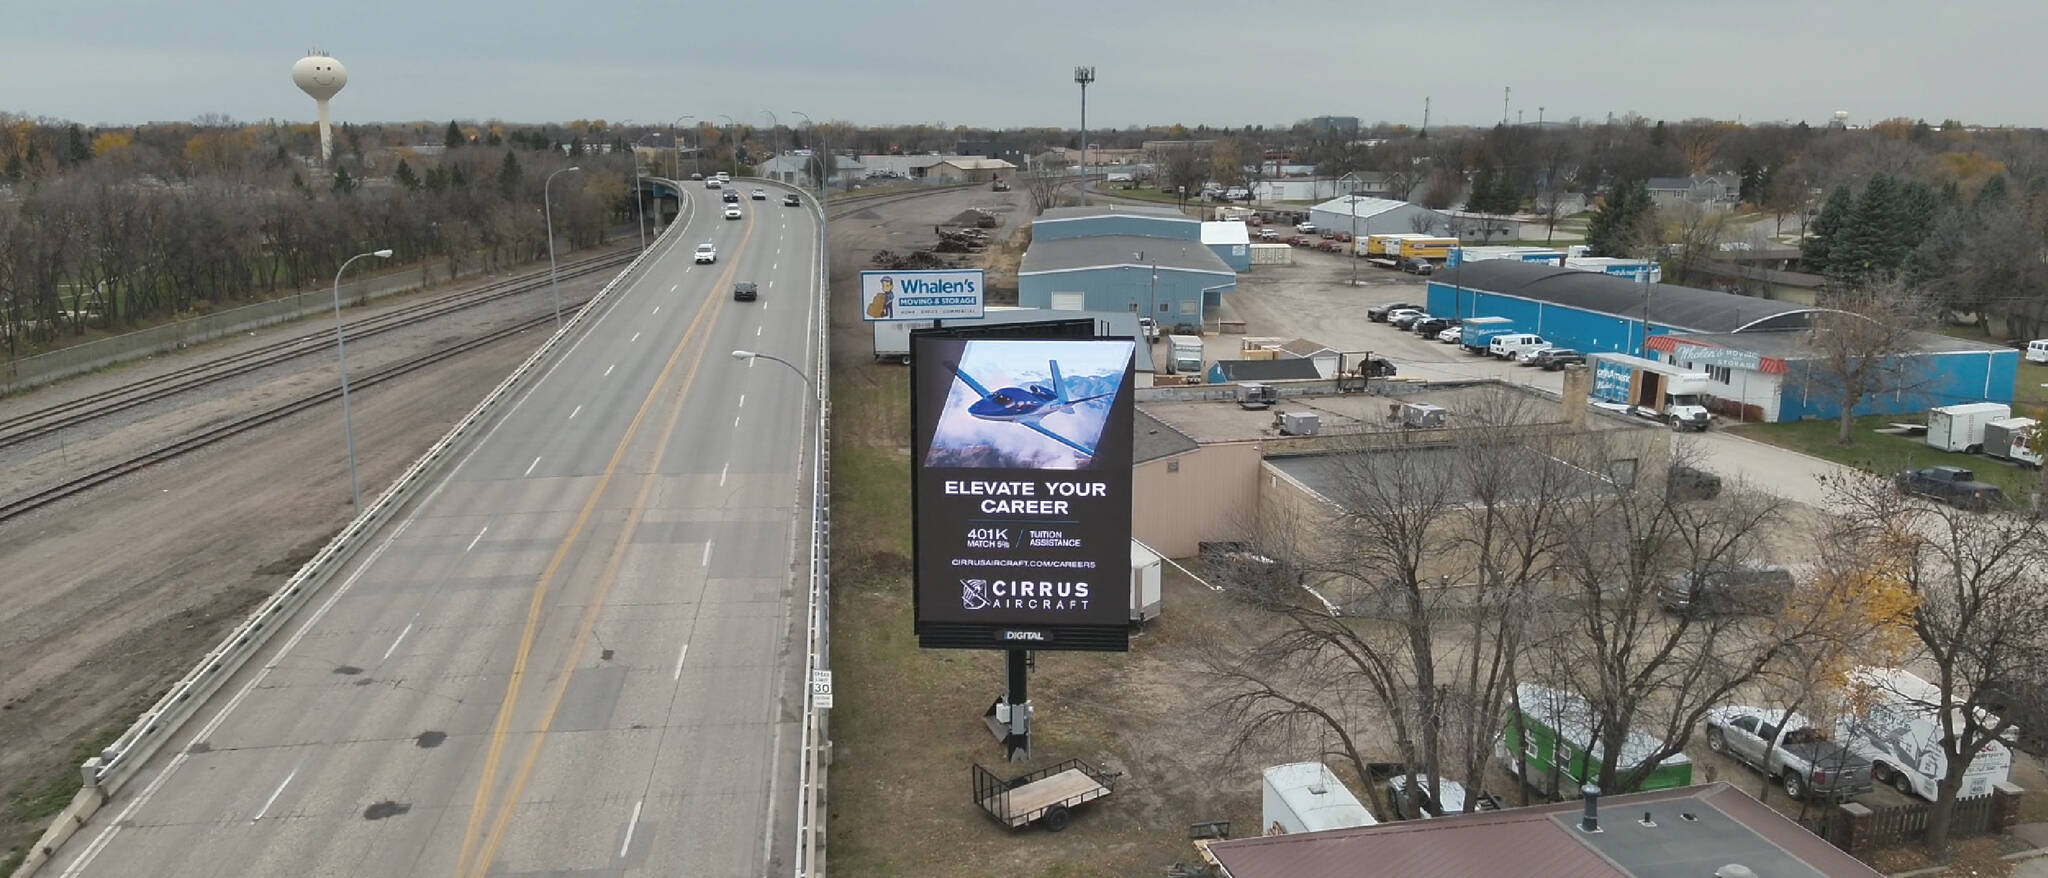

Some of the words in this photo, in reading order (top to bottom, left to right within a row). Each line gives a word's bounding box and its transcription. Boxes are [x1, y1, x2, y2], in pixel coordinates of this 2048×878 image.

[900, 279, 975, 293] Whalen's
[944, 480, 1035, 496] ELEVATE
[1045, 482, 1107, 497] YOUR
[980, 499, 1069, 515] CAREER
[967, 528, 1008, 540] 401K
[1029, 530, 1062, 539] TUITION
[967, 540, 995, 548] MATCH
[1029, 539, 1081, 547] ASSISTANCE
[951, 559, 1096, 569] CIRRUSAIRCRAFT.COM/CAREERS
[992, 580, 1089, 597] CIRRUS
[992, 599, 1089, 610] AIRCRAFT
[1006, 631, 1044, 640] DIGITAL
[815, 683, 830, 693] 30
